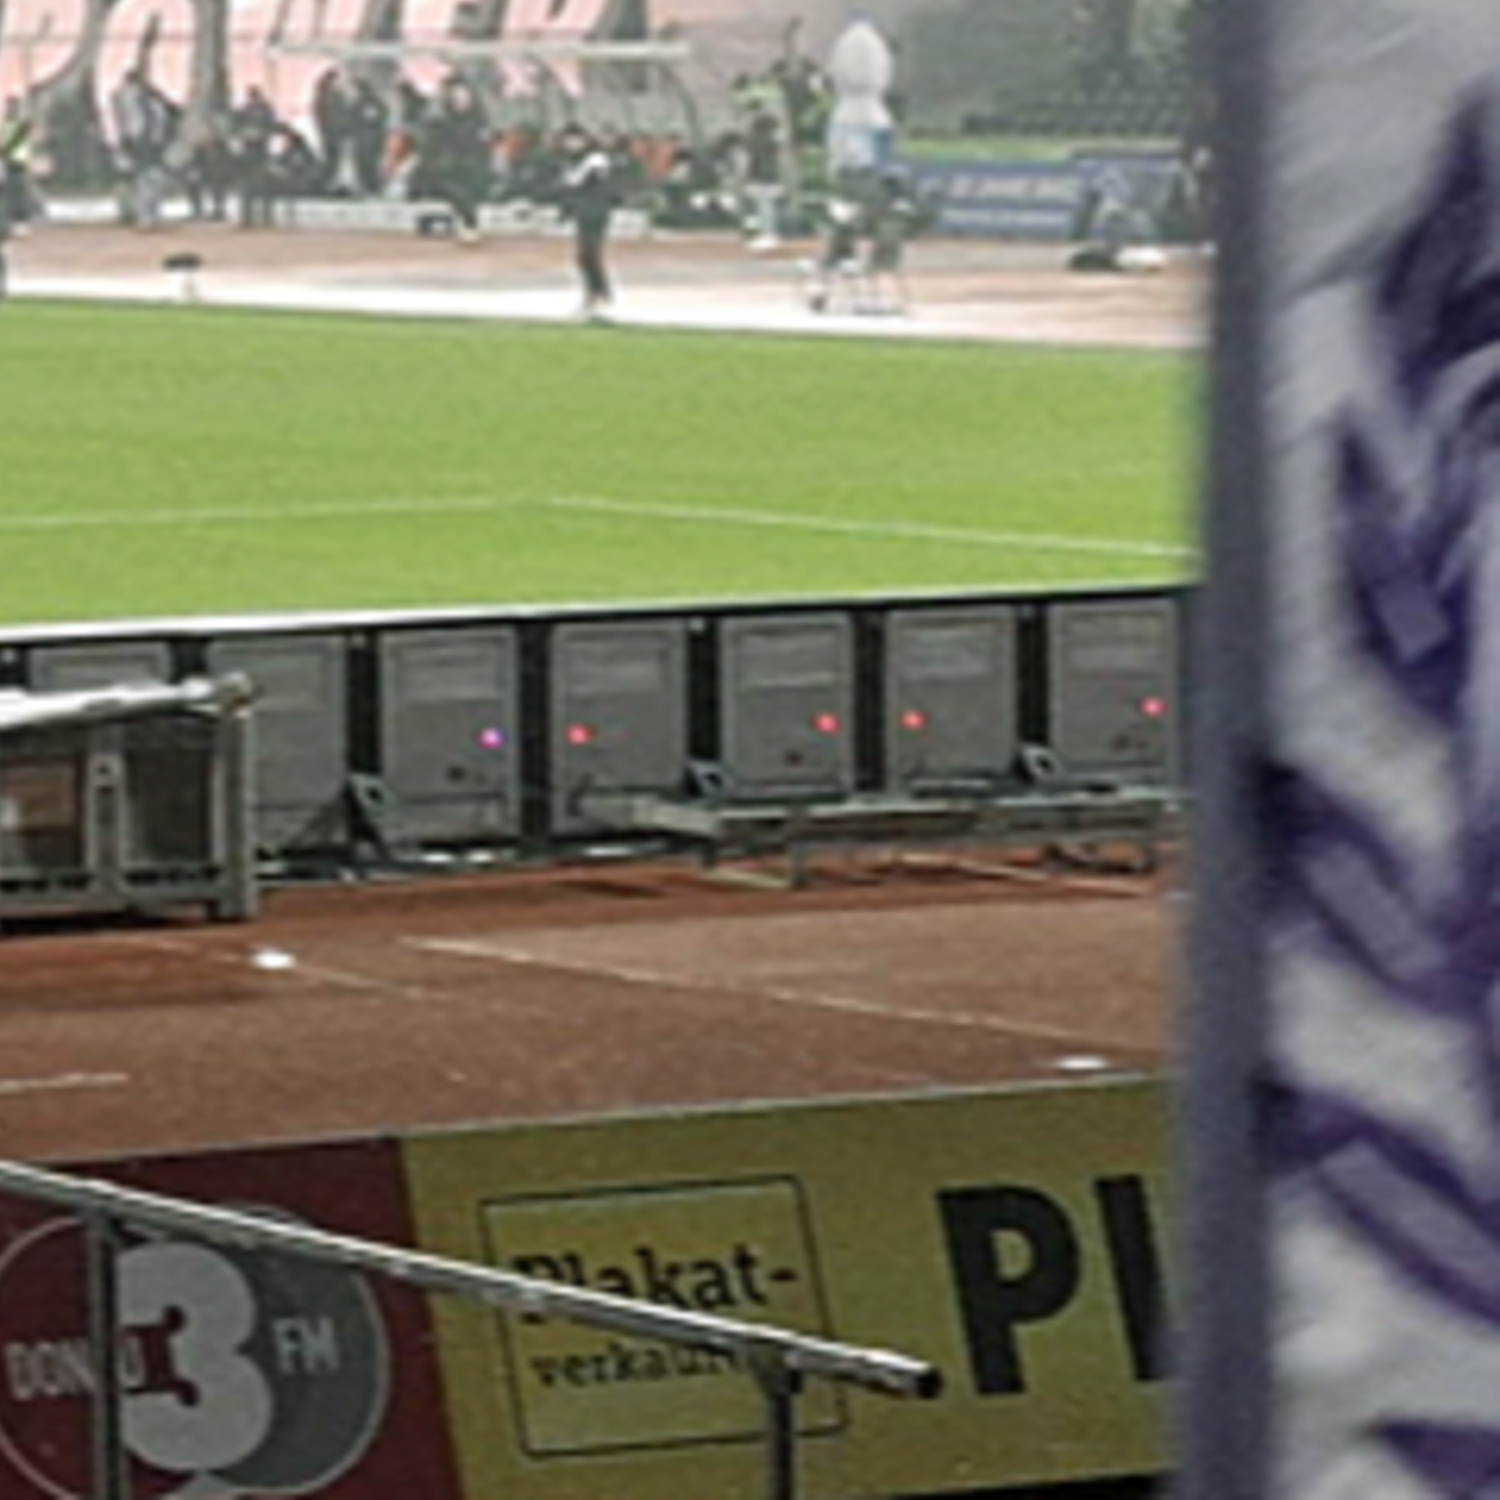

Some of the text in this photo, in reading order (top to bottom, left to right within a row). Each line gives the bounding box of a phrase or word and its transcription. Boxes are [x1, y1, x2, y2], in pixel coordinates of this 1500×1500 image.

[4, 1240, 342, 1472] DONU 3 FM
